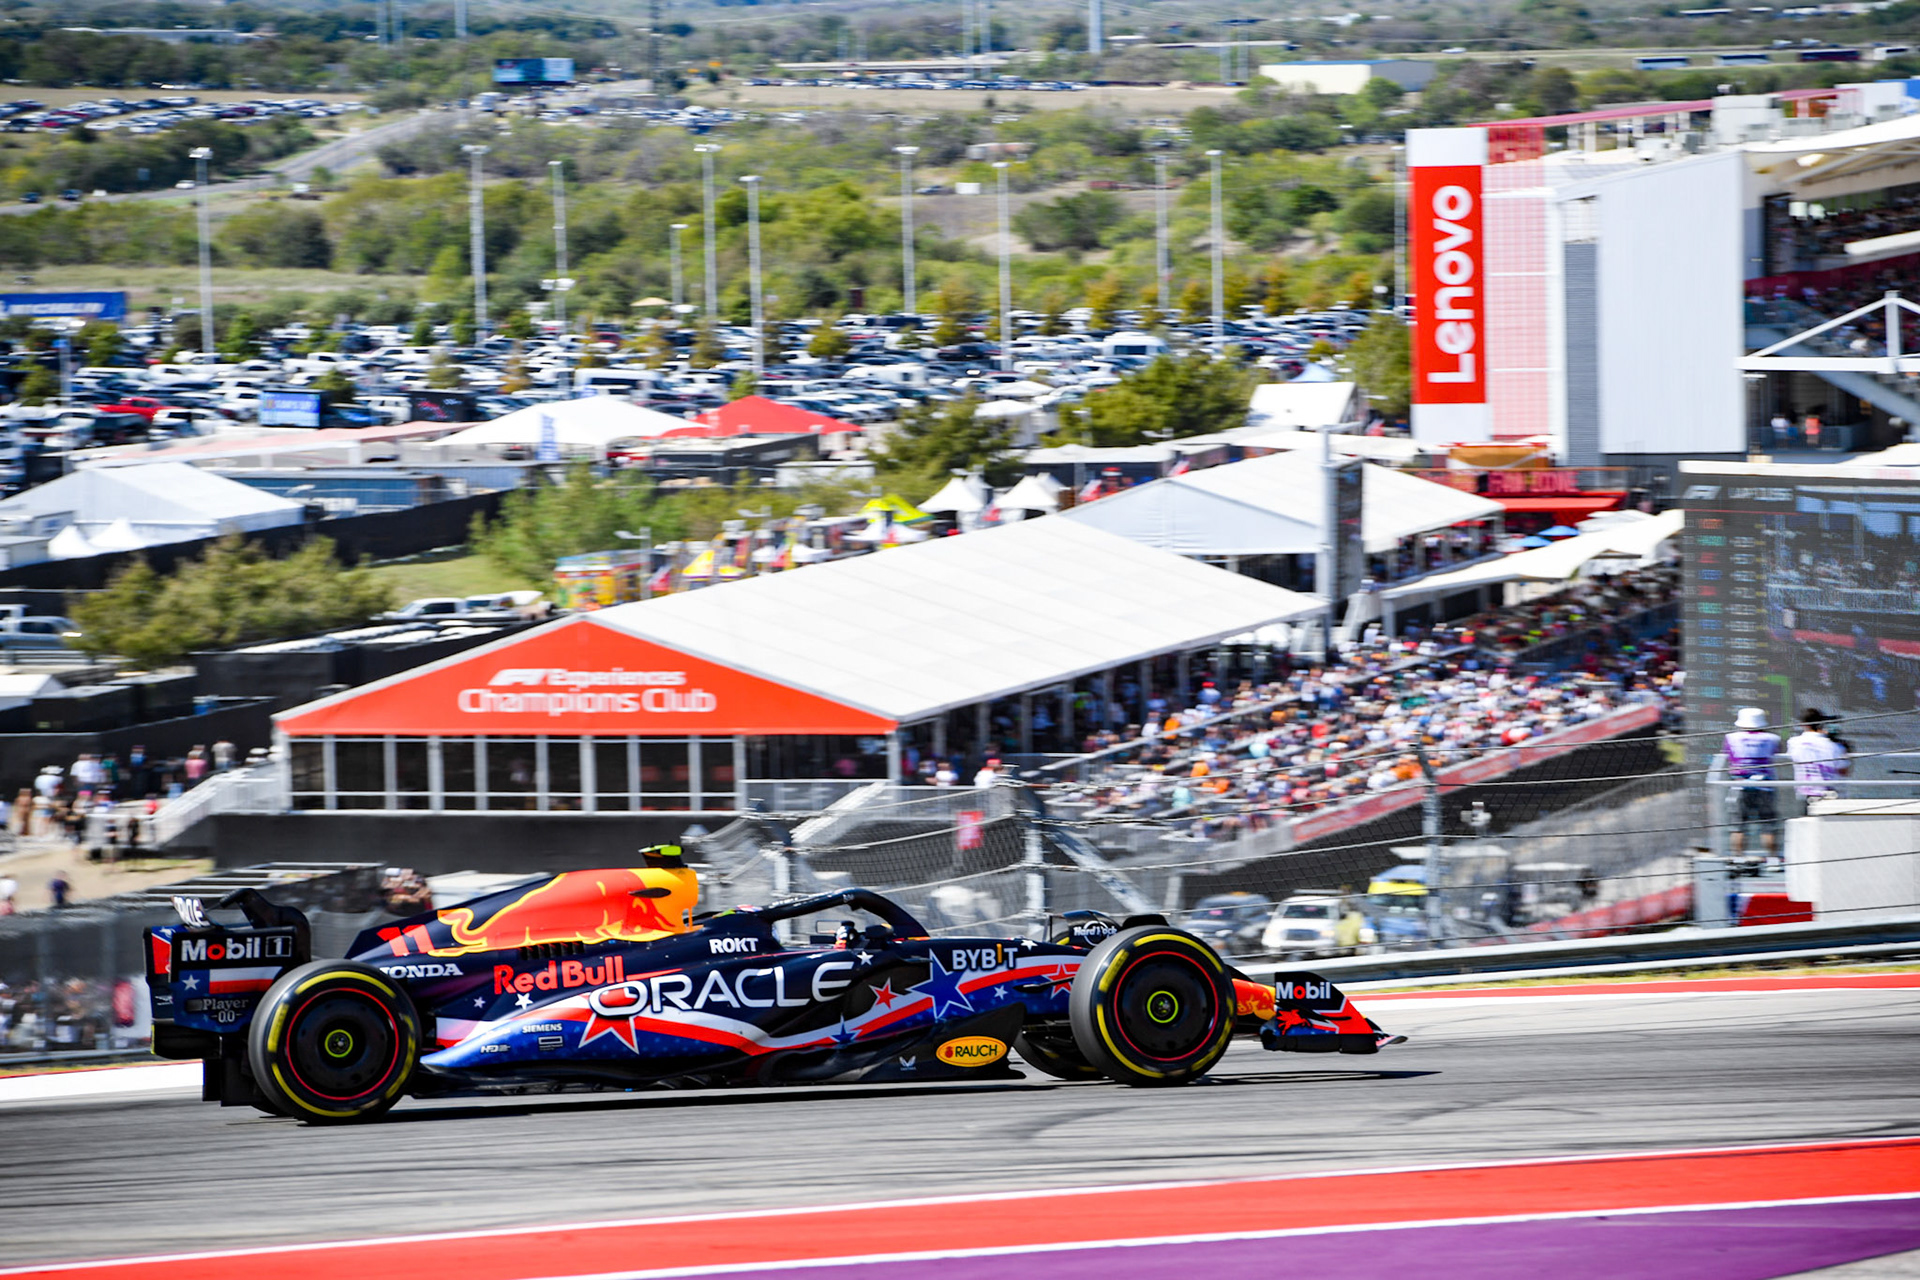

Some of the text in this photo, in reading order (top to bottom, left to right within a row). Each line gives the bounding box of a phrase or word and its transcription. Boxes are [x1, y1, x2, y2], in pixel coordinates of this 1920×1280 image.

[1427, 185, 1476, 383] Lenovo
[547, 667, 687, 688] Experiences
[458, 687, 717, 716] Champions Club
[376, 924, 435, 957] 11
[1073, 926, 1096, 936] Hard
[181, 937, 261, 961] Mobil
[709, 937, 758, 954] ROKT
[952, 944, 1018, 970] BYBIT
[493, 956, 625, 995] Red Bull
[589, 961, 855, 1017] ORACLE
[1275, 981, 1331, 999] Mobil
[202, 998, 248, 1012] Player
[522, 1023, 563, 1034] SIEMENS
[954, 1044, 998, 1058] RAUCH
